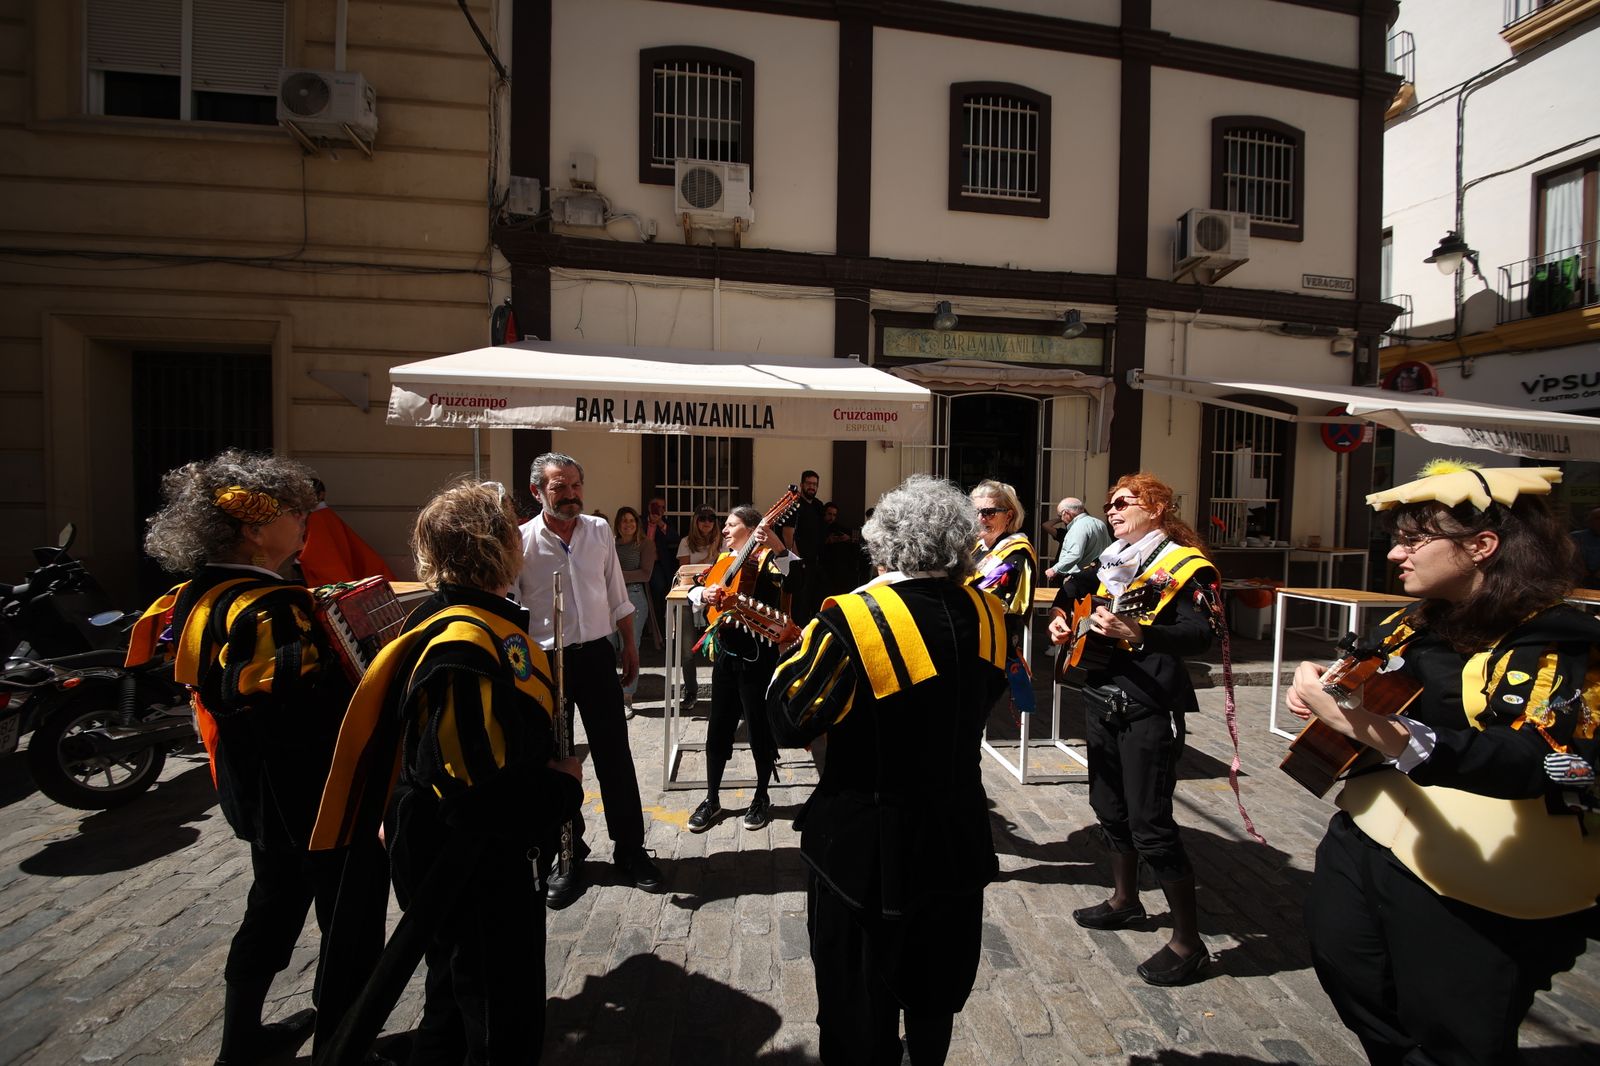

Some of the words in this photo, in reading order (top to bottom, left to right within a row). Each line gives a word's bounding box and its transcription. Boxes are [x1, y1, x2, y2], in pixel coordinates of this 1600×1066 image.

[1305, 276, 1352, 290] VERACRUZ
[943, 334, 964, 352] BAR
[967, 335, 977, 351] LA
[978, 335, 1045, 353] MANZANILLA
[428, 393, 508, 410] Cruzcampo
[1538, 392, 1580, 403] CENTRO
[575, 397, 615, 423] BAR
[623, 399, 646, 424] LA
[654, 400, 775, 430] MANZANILLA
[833, 407, 899, 423] Cruzcampo
[845, 423, 888, 433] ESPECIAL
[1462, 427, 1487, 444] BAR
[1486, 429, 1504, 447] LA
[1504, 431, 1571, 453] MANZANILLA
